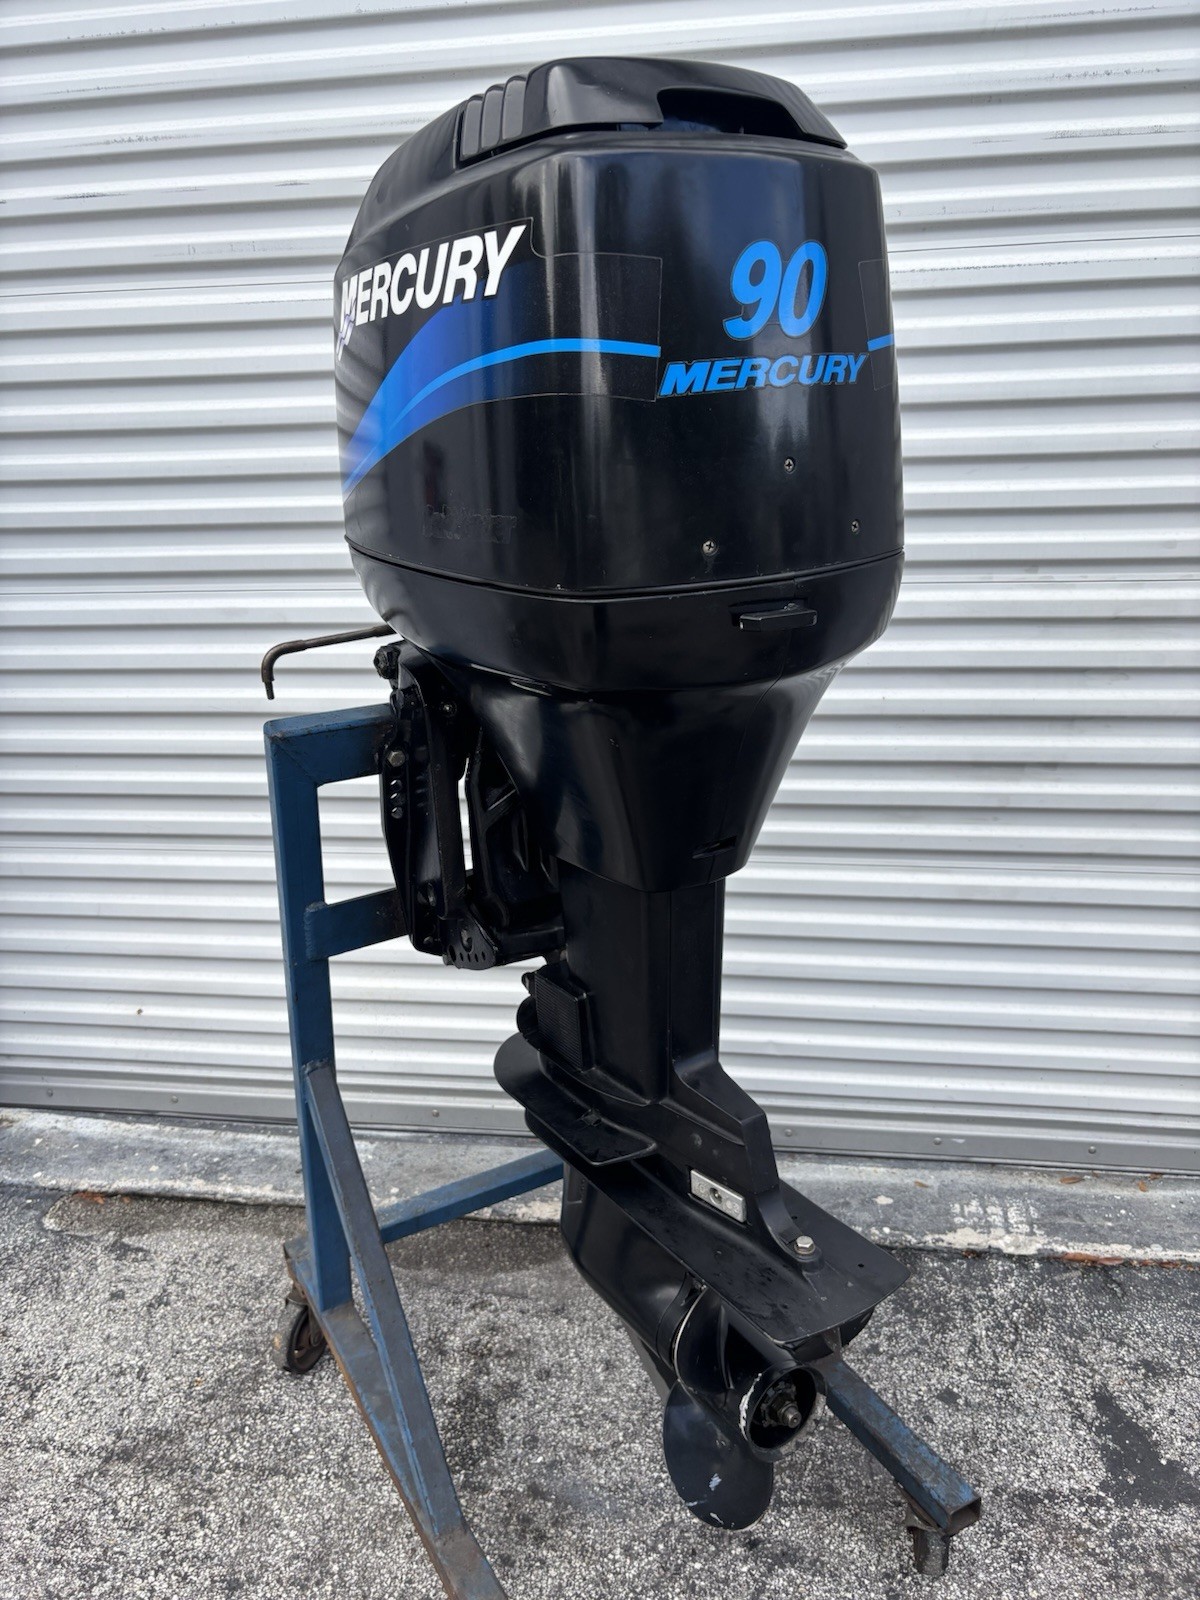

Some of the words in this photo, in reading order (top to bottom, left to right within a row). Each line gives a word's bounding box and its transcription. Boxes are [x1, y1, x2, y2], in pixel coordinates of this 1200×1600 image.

[337, 225, 527, 361] MERCURY
[723, 240, 828, 340] 90
[659, 353, 868, 397] MERCURY
